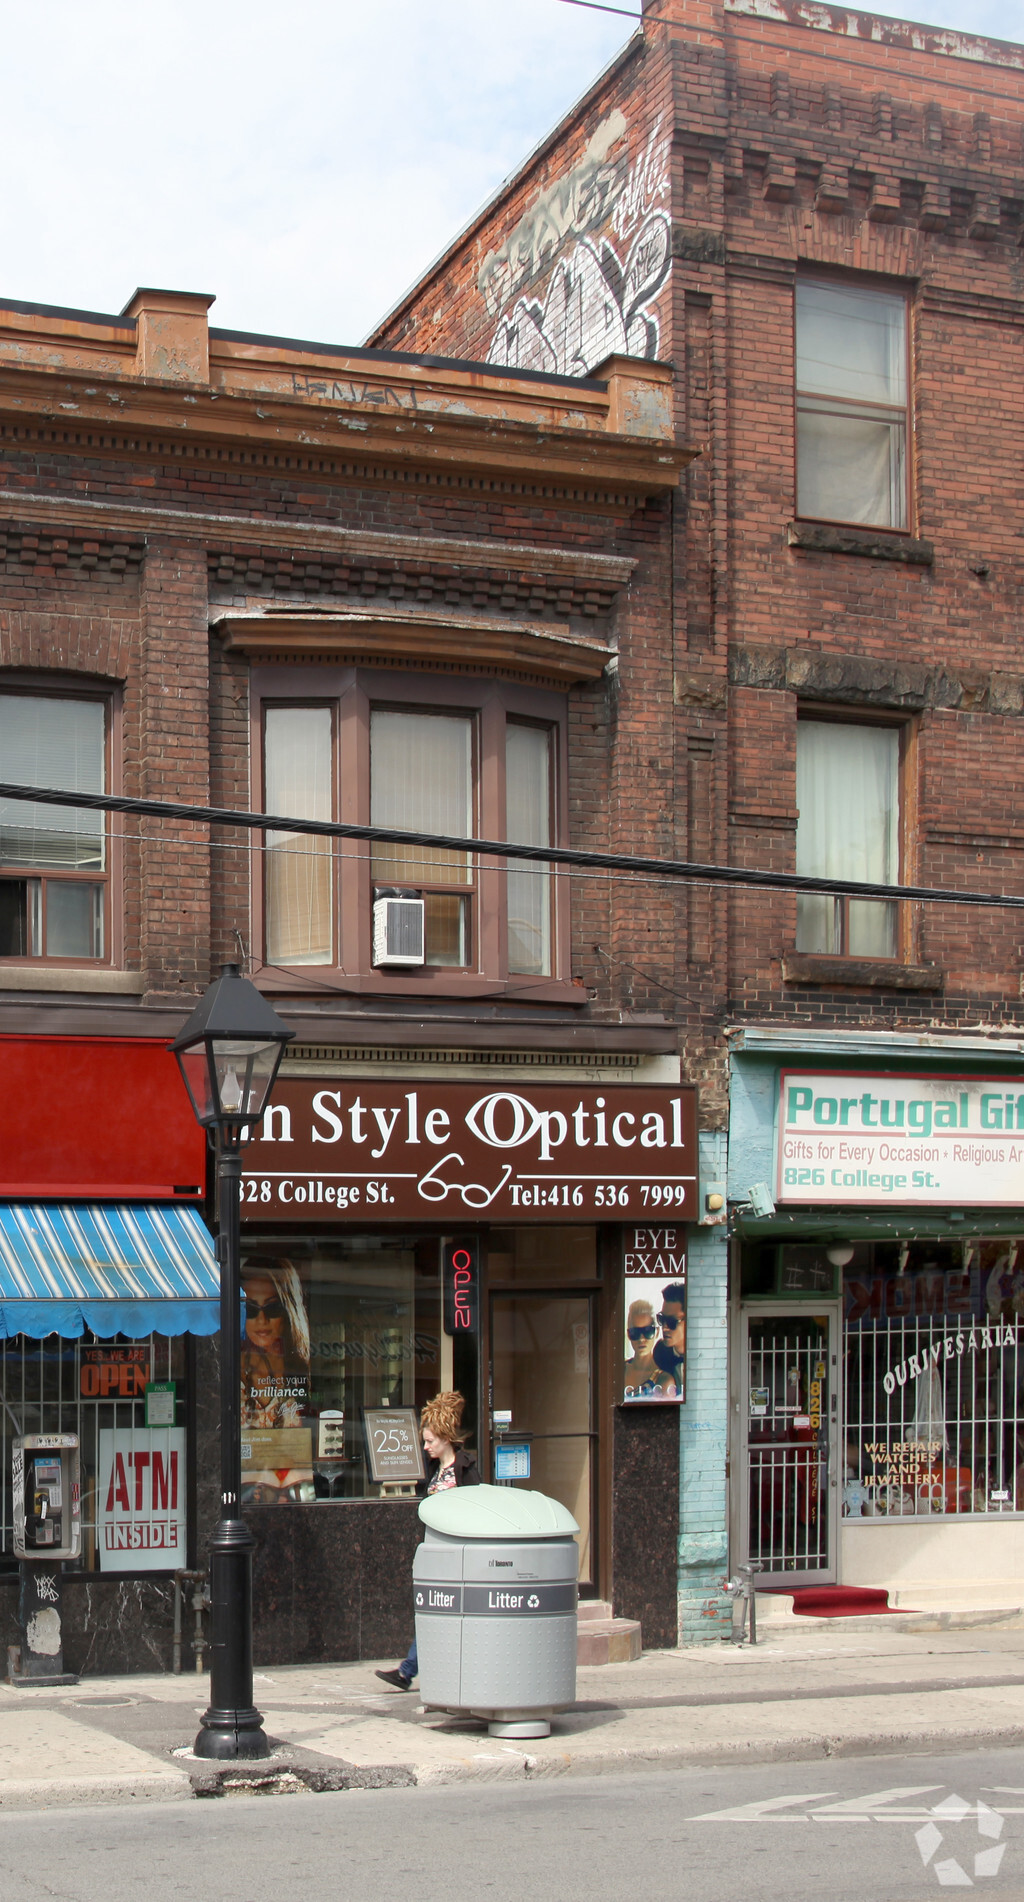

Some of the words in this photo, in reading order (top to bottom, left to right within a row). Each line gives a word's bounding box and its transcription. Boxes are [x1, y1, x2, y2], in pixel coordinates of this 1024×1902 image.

[786, 1086, 969, 1138] Portugal
[311, 1090, 451, 1159] Style
[464, 1092, 685, 1161] Optical
[783, 1140, 813, 1160] Gifts
[818, 1141, 835, 1161] for
[839, 1142, 875, 1165] Every
[879, 1143, 939, 1163] Occasion
[953, 1144, 1005, 1166] Religious
[784, 1167, 825, 1186] 826
[831, 1169, 907, 1192] College
[912, 1170, 940, 1188] St.
[278, 1180, 360, 1209] College
[366, 1181, 395, 1204] St.
[508, 1184, 584, 1206] Tel:416
[594, 1185, 630, 1206] 536
[640, 1185, 686, 1207] 7999
[633, 1229, 677, 1249] EYE
[624, 1254, 686, 1274] EXAM
[452, 1249, 472, 1329] OPEN
[127, 1350, 145, 1361] ARE
[883, 1323, 1016, 1395] OURIVESARIA
[80, 1363, 150, 1396] OPEN
[257, 1375, 285, 1386] reflect
[286, 1376, 307, 1387] your
[250, 1386, 308, 1399] brilliance.
[810, 1381, 821, 1429] 826
[374, 1429, 409, 1453] 25%
[401, 1444, 414, 1452] OFF
[864, 1442, 887, 1453] WE
[892, 1441, 942, 1452] REPAIR
[870, 1453, 937, 1463] WATCHES
[888, 1463, 921, 1474] AND
[105, 1450, 178, 1512] ATM
[863, 1474, 941, 1487] JEWELLERY
[106, 1522, 177, 1548] INSIDE
[429, 1590, 455, 1608] Litter
[488, 1591, 524, 1608] Litter
